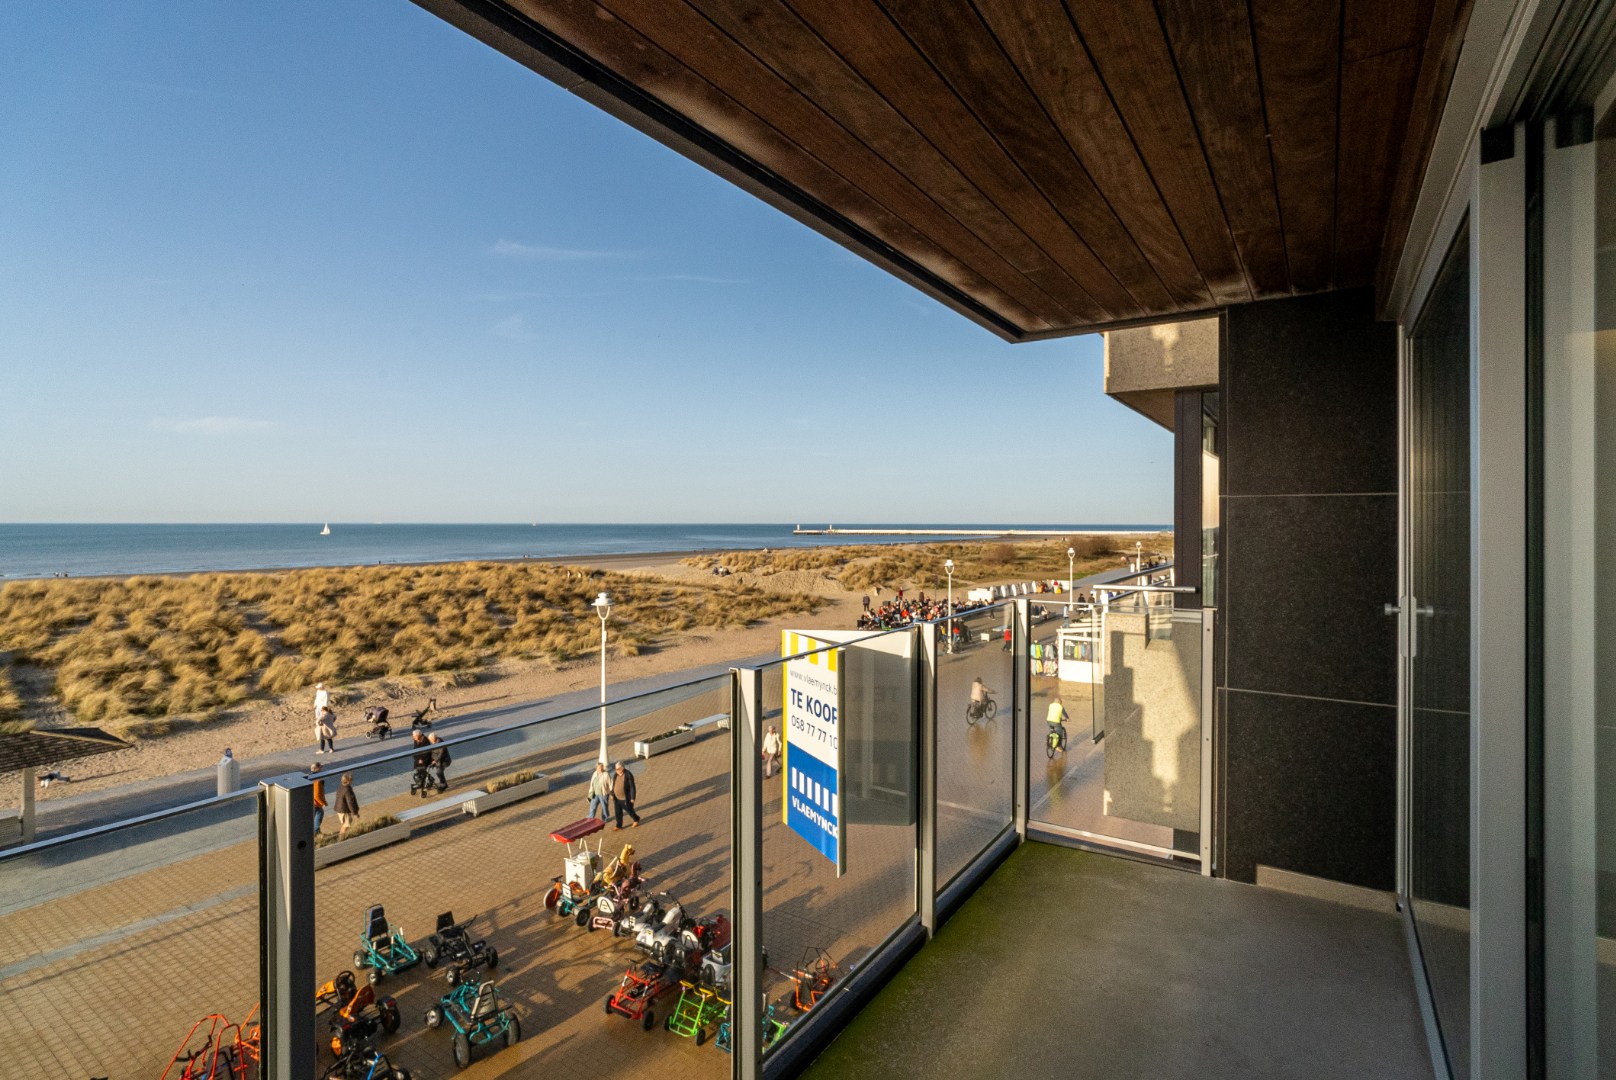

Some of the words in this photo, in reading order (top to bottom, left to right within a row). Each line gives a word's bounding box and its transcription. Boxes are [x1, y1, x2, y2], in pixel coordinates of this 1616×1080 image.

[791, 688, 803, 709] TE
[792, 715, 805, 731] 058
[807, 722, 816, 737] 77
[818, 728, 827, 743] 77
[792, 795, 838, 840] VLAEMYNCK
